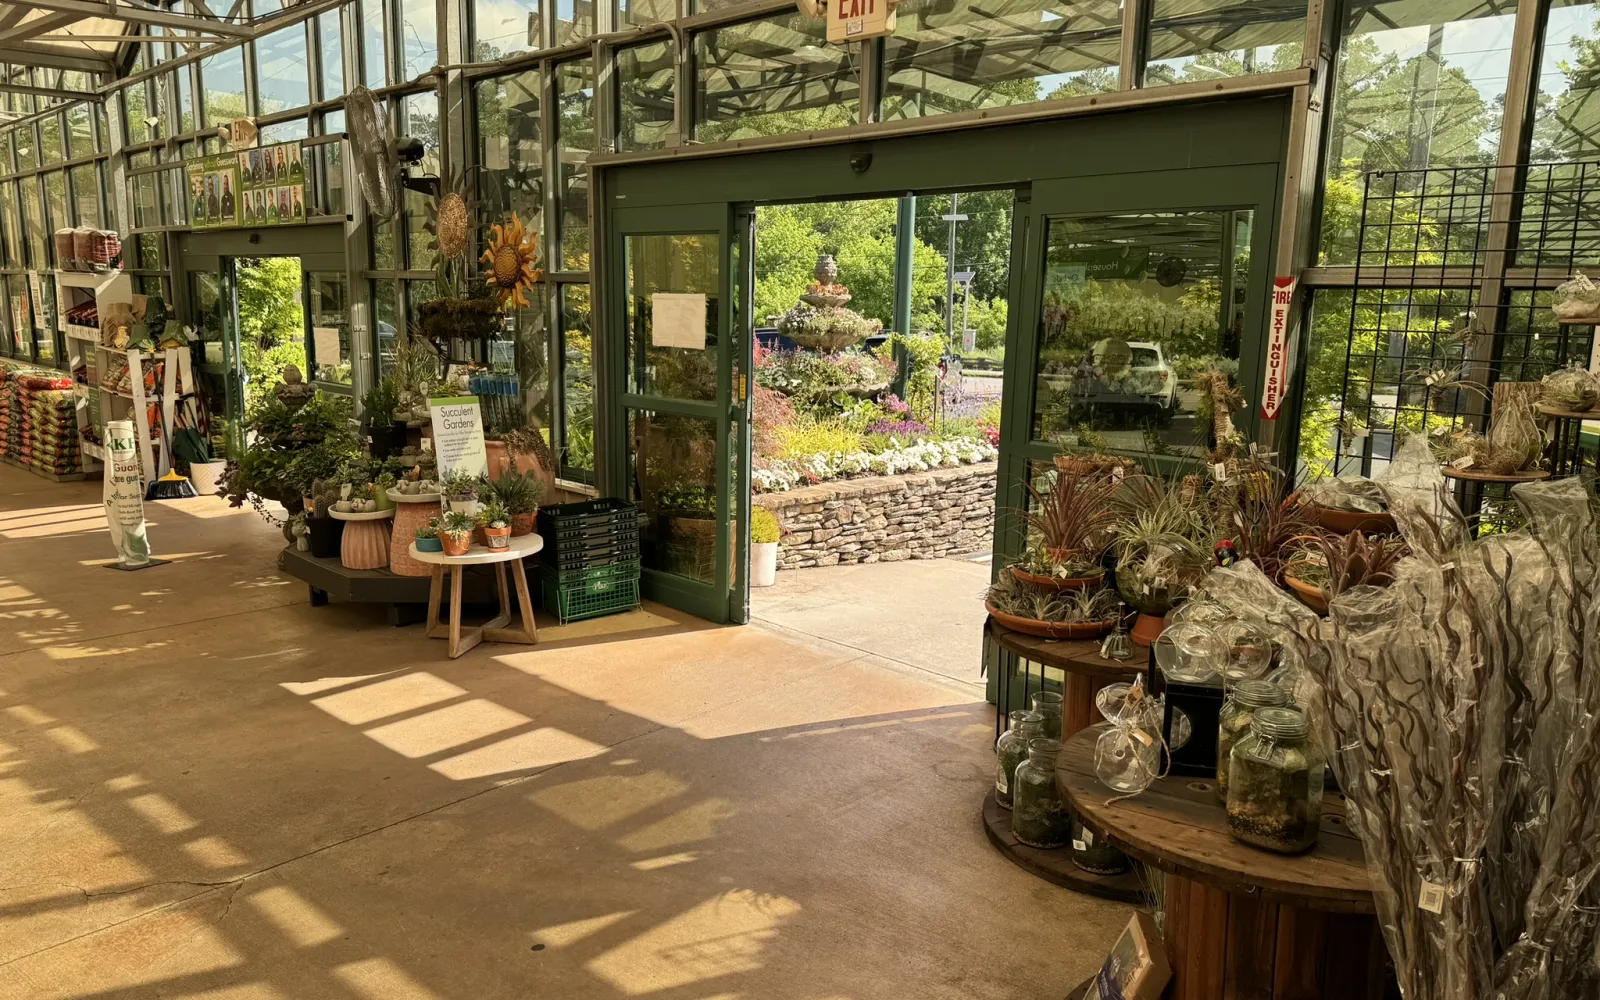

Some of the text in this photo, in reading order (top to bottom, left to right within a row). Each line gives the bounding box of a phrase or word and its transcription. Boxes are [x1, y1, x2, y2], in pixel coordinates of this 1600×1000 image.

[1272, 291, 1292, 304] FIRE
[1266, 309, 1285, 410] EXTINGUISHER
[440, 405, 474, 418] Succulent
[443, 417, 475, 430] Gardens
